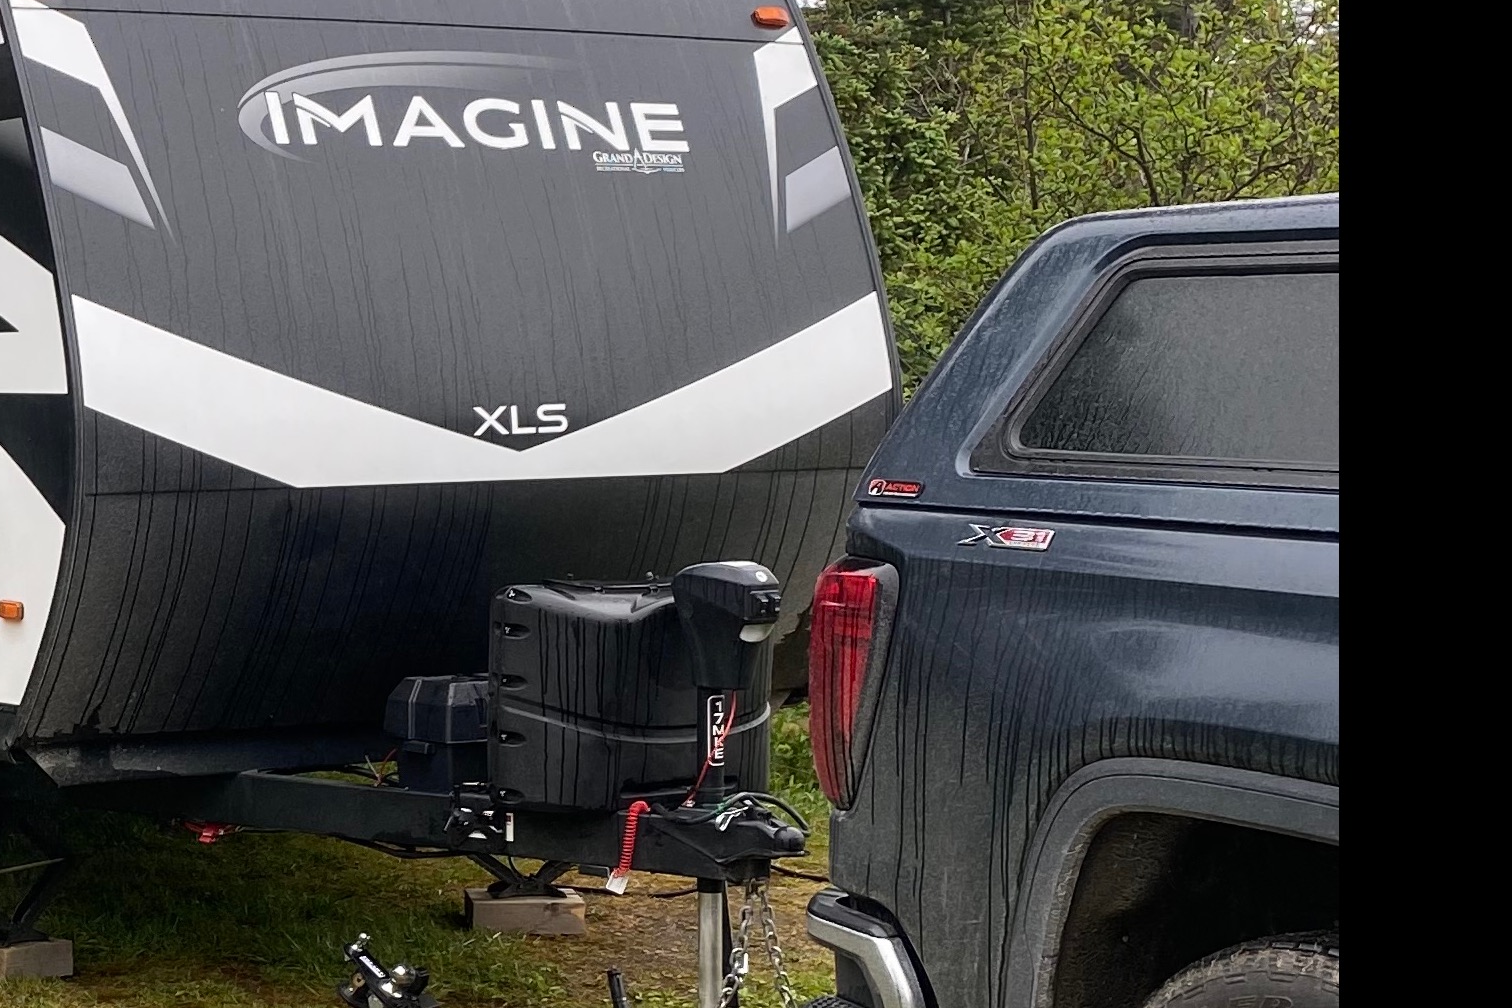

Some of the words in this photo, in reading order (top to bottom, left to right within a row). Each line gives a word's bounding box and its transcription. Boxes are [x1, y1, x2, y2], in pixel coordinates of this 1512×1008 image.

[264, 91, 690, 152] IMAGINE
[593, 151, 633, 163] GRAND
[643, 153, 682, 164] DESIGN
[473, 403, 568, 436] XLS
